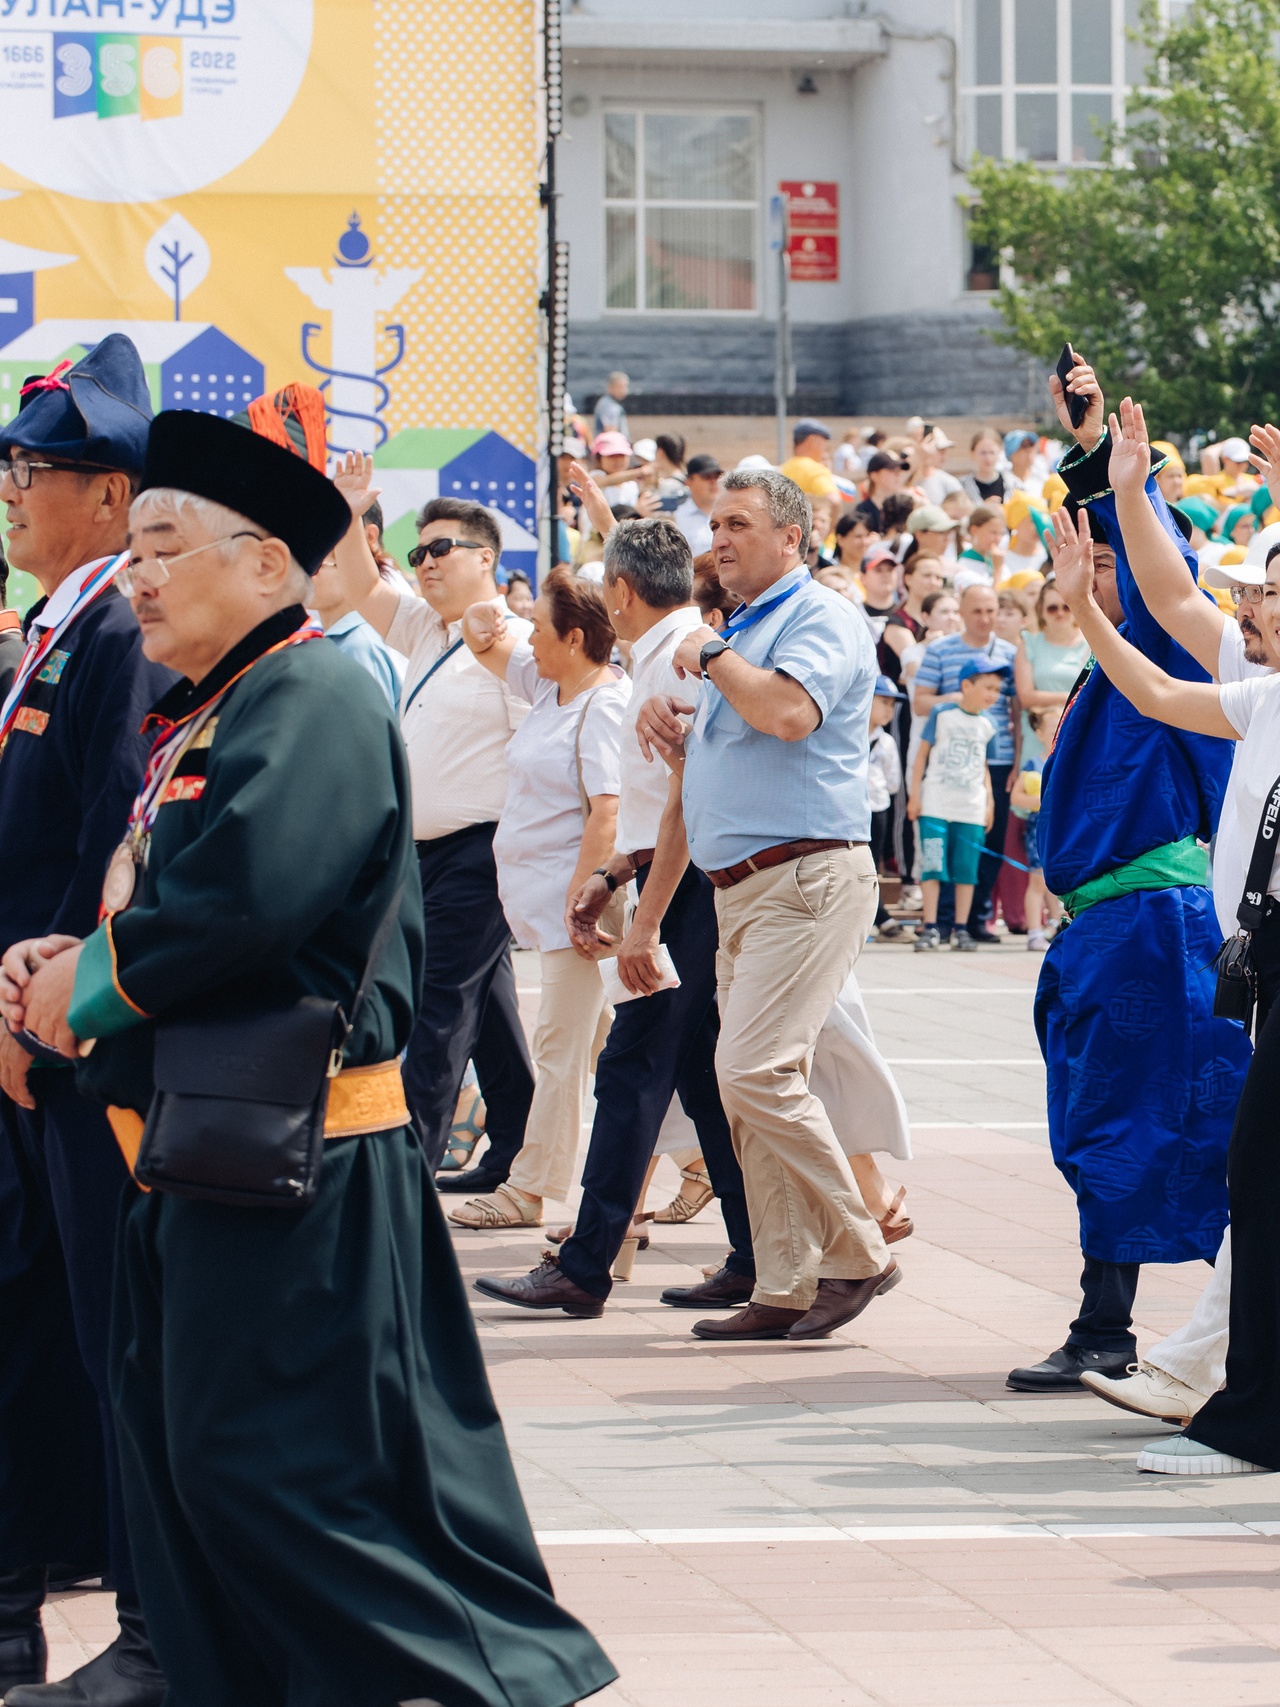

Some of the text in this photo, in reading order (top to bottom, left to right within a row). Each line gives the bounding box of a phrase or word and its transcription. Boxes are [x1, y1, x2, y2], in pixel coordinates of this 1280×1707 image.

[3, 45, 44, 63] 1666
[190, 51, 236, 69] 2022
[55, 43, 181, 99] 356
